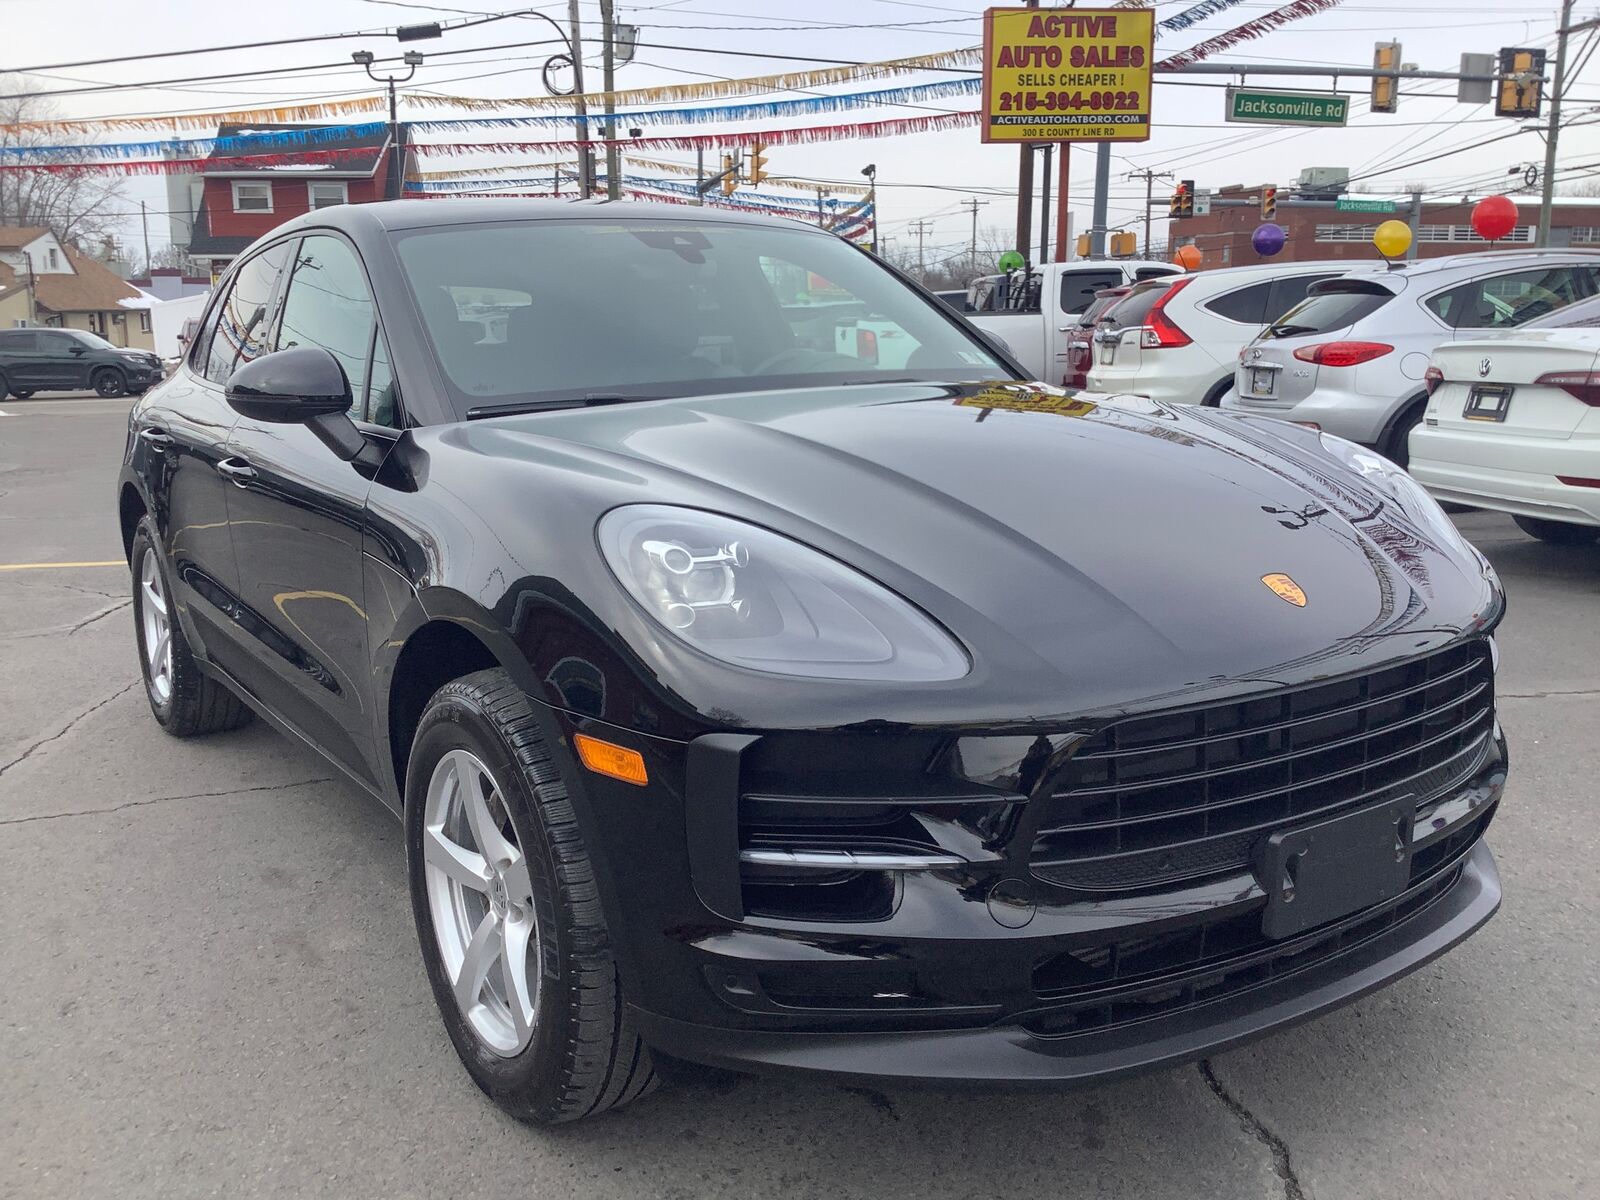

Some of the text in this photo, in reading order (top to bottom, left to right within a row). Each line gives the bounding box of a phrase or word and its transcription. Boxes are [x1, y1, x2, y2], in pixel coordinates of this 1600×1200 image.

[1027, 16, 1117, 38] ACTIVE
[997, 45, 1145, 68] AUTO SALES
[1017, 74, 1055, 87] SELLS
[1060, 74, 1117, 87] CHEAPER
[999, 91, 1140, 111] 215-394-8922
[1237, 99, 1344, 118] Jacksonville Rd
[997, 115, 1139, 125] ACTIVEAUTOHATBORO.COM
[1022, 128, 1115, 137] 300 E COUNTY LINE RD
